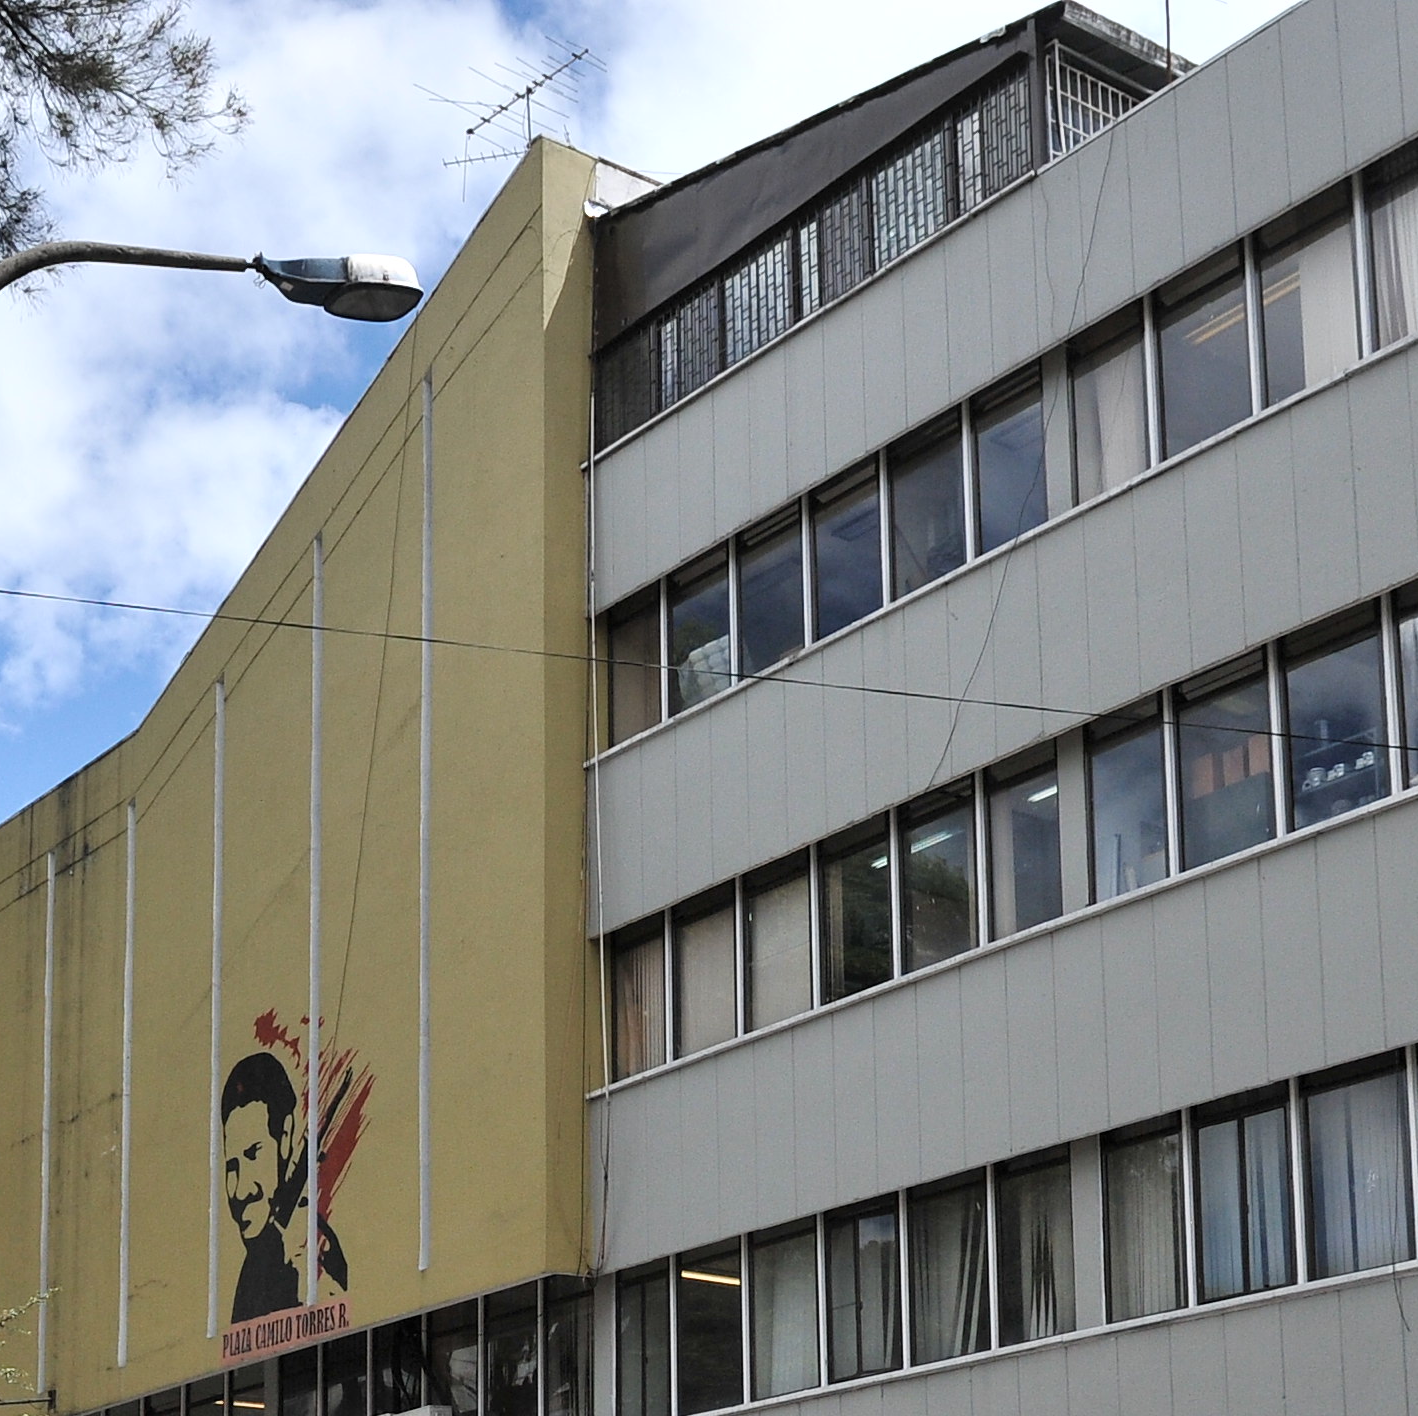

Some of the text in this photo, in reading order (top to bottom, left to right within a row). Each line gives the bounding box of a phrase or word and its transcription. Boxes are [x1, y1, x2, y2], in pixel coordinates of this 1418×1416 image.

[222, 1327, 252, 1359] PLAZA
[255, 1315, 293, 1350] CAMILO
[295, 1305, 336, 1340] TORRES
